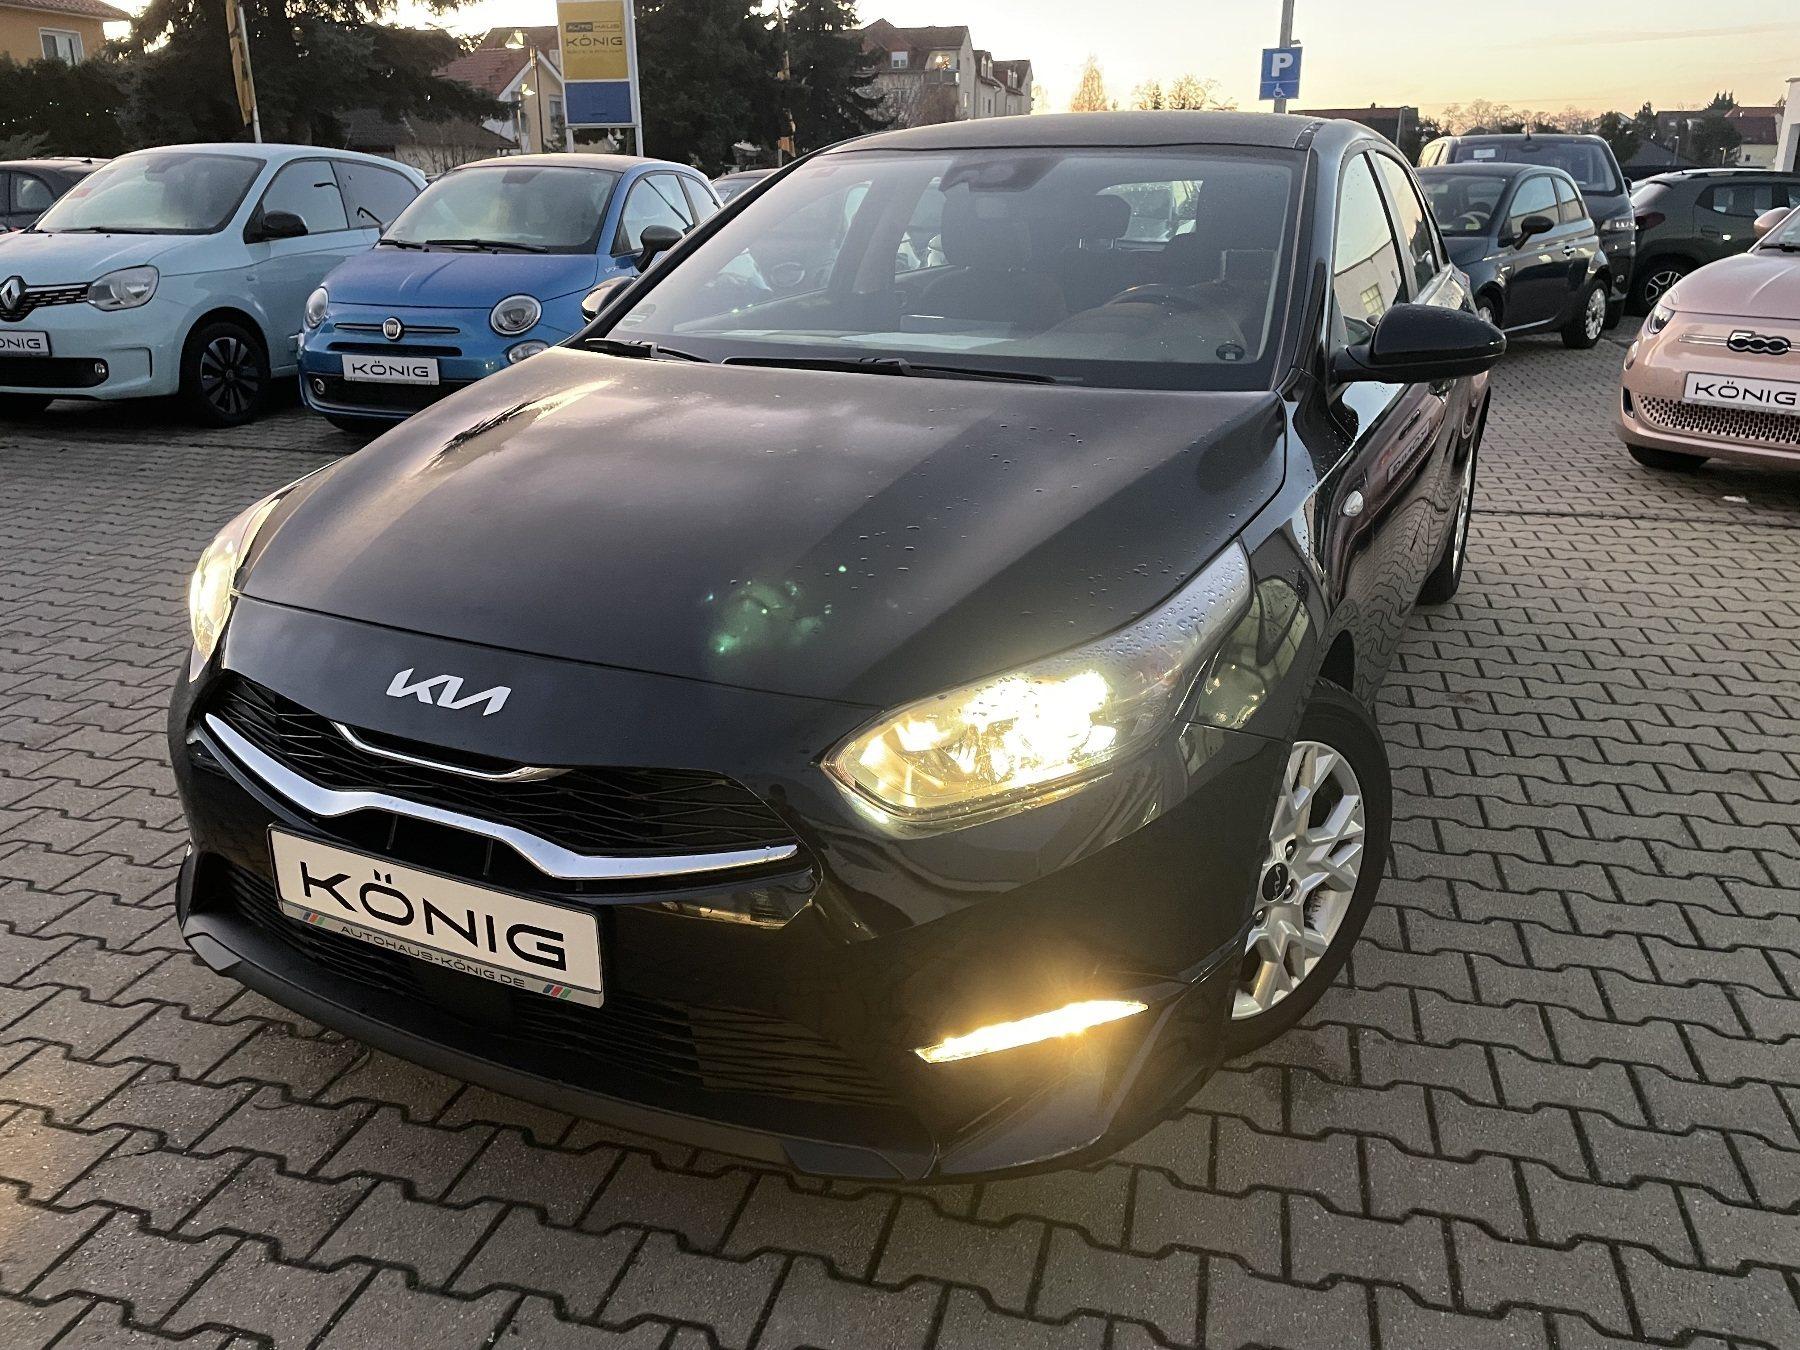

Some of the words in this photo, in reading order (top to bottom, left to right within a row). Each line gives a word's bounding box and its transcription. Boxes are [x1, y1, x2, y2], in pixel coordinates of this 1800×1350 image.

[566, 35, 623, 46] KÖNIG
[1272, 53, 1294, 77] P
[352, 361, 429, 378] KÖNIG
[1695, 381, 1797, 406] KÖNIG
[300, 861, 567, 971] KÖNIG
[341, 926, 525, 988] AUTOHAUS-KÖNIG.DE
